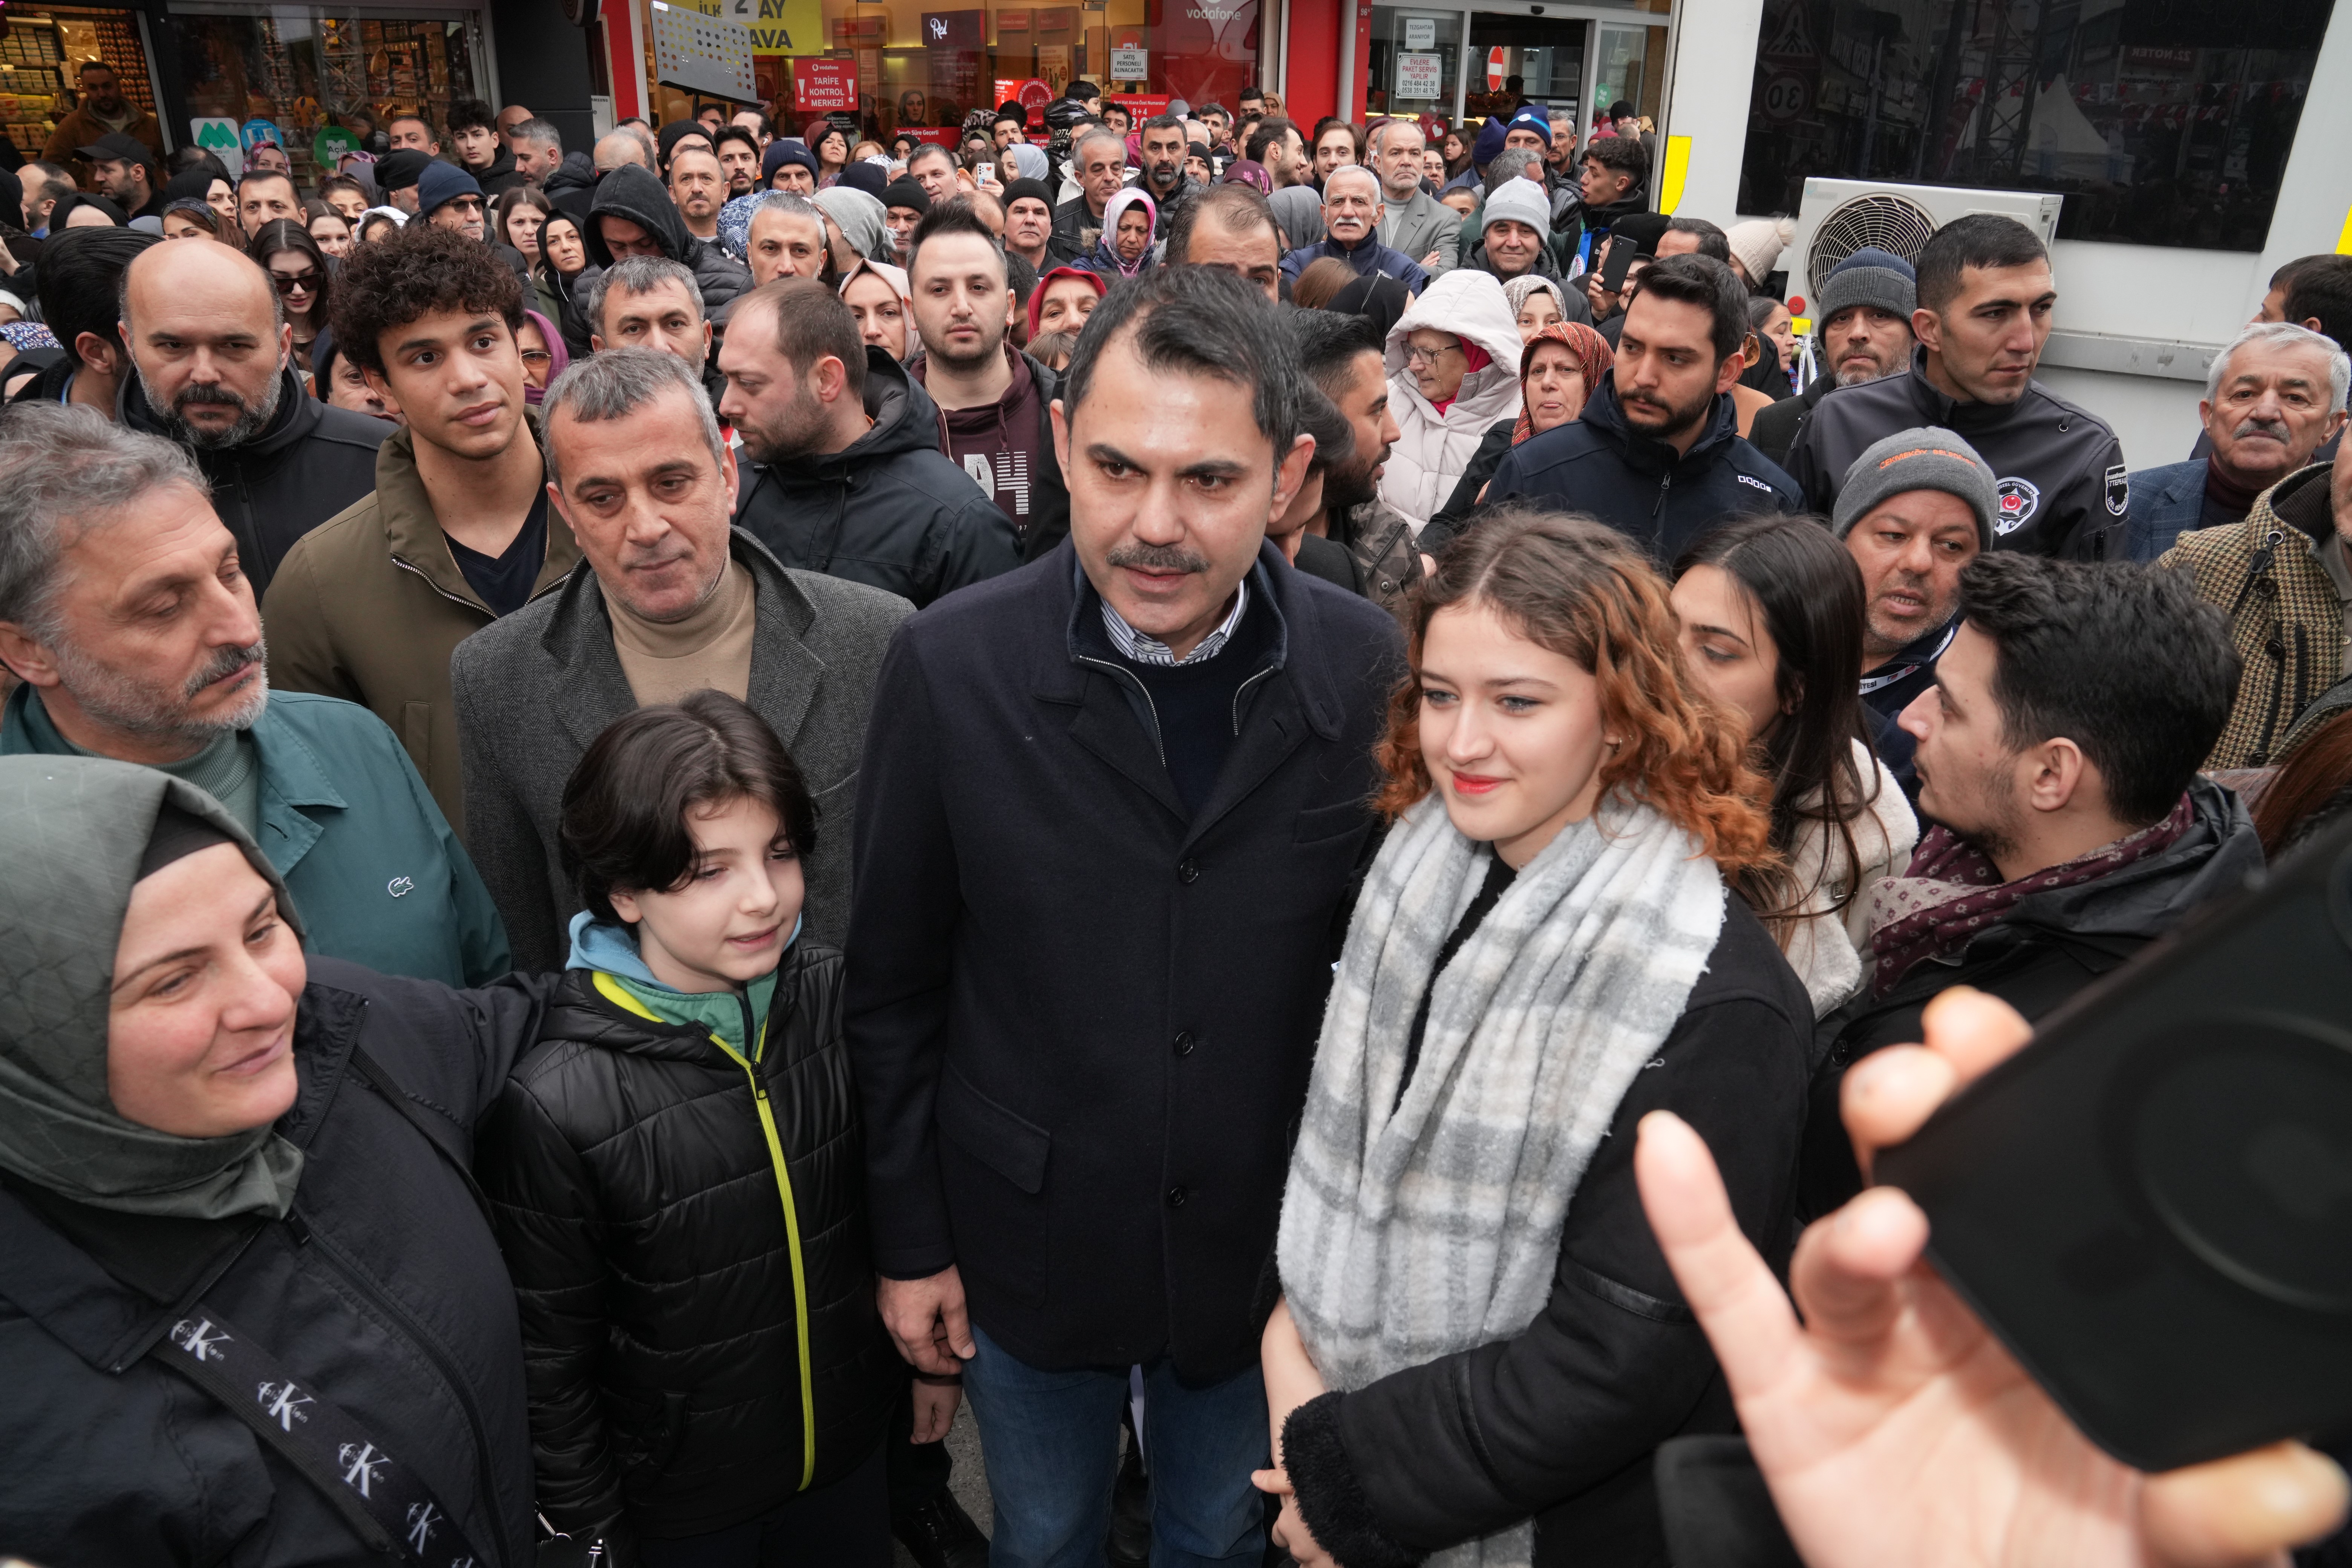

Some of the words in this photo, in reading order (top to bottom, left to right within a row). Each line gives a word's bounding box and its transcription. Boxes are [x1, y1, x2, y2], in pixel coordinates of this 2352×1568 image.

[699, 0, 722, 17] İLK
[758, 0, 785, 18] AY
[1186, 6, 1241, 20] vodafone
[930, 18, 947, 40] Red
[749, 29, 793, 48] AVA
[813, 75, 839, 85] TARİFE
[1038, 81, 1050, 93] SALES
[811, 97, 844, 107] MERKEZİ
[1053, 129, 1072, 139] ORTH
[328, 145, 349, 154] Açık
[2012, 482, 2035, 495] GÜVENLİK
